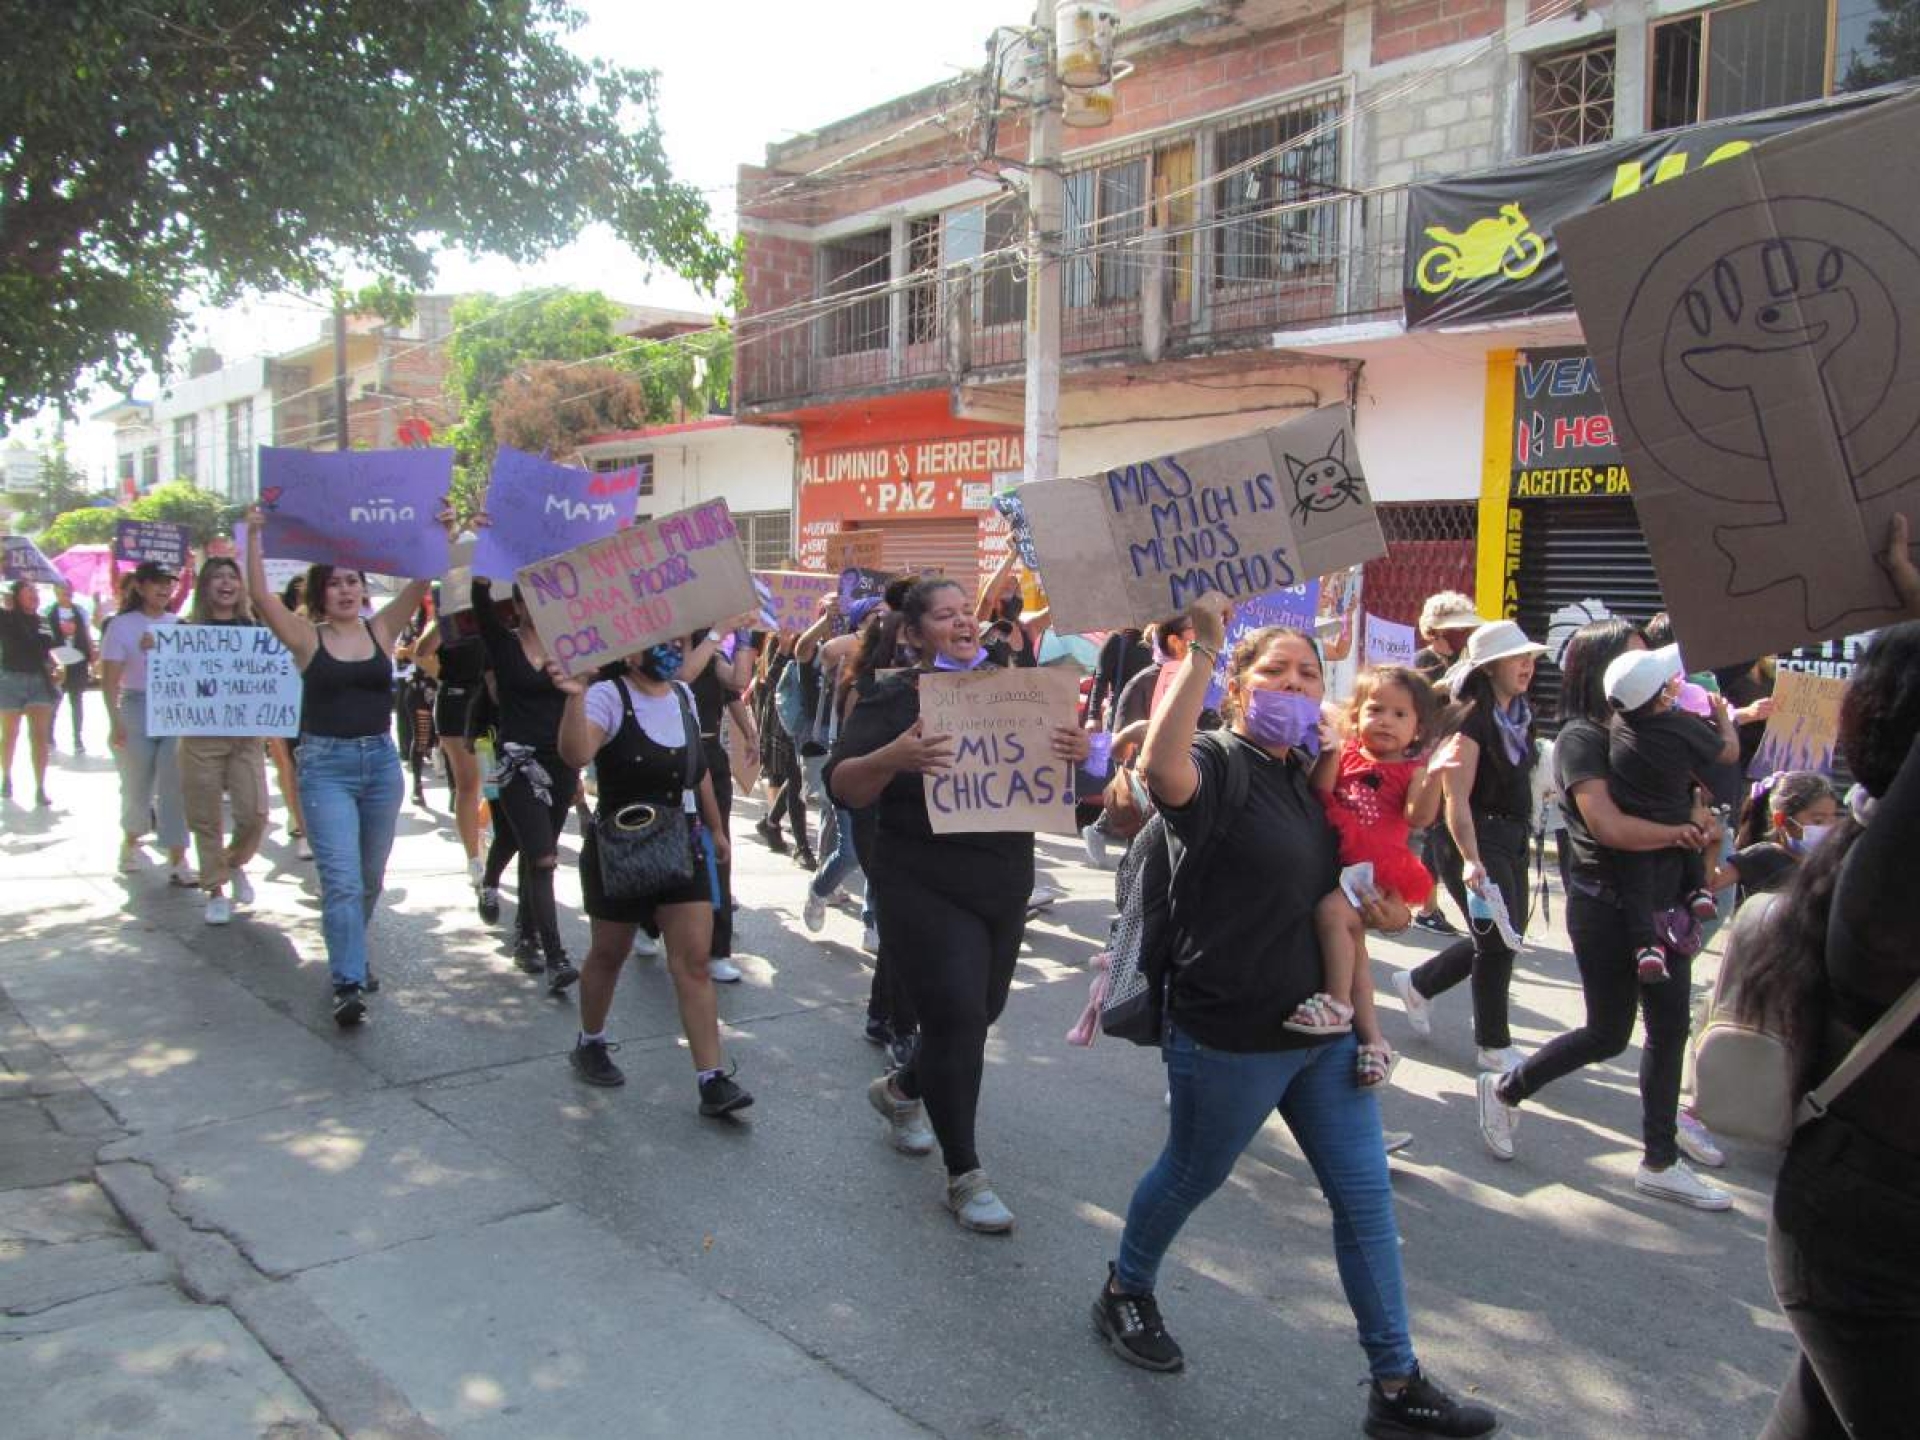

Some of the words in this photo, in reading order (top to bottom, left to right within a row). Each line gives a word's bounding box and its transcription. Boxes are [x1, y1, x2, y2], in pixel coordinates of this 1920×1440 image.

[1553, 413, 1618, 450] He
[801, 449, 889, 484] ALUMINIO
[917, 437, 1022, 474] HERRERIA
[877, 481, 936, 513] PAZ
[1107, 455, 1193, 513] MAS
[1517, 468, 1592, 497] ACEITES
[350, 497, 415, 525] niña
[544, 493, 616, 522] MATA
[1129, 523, 1240, 578] MENOS
[530, 561, 579, 606] NO
[1169, 548, 1295, 610] MACHOS
[156, 628, 243, 654] MARCHO
[196, 678, 218, 698] NO
[956, 733, 1025, 767] MIS
